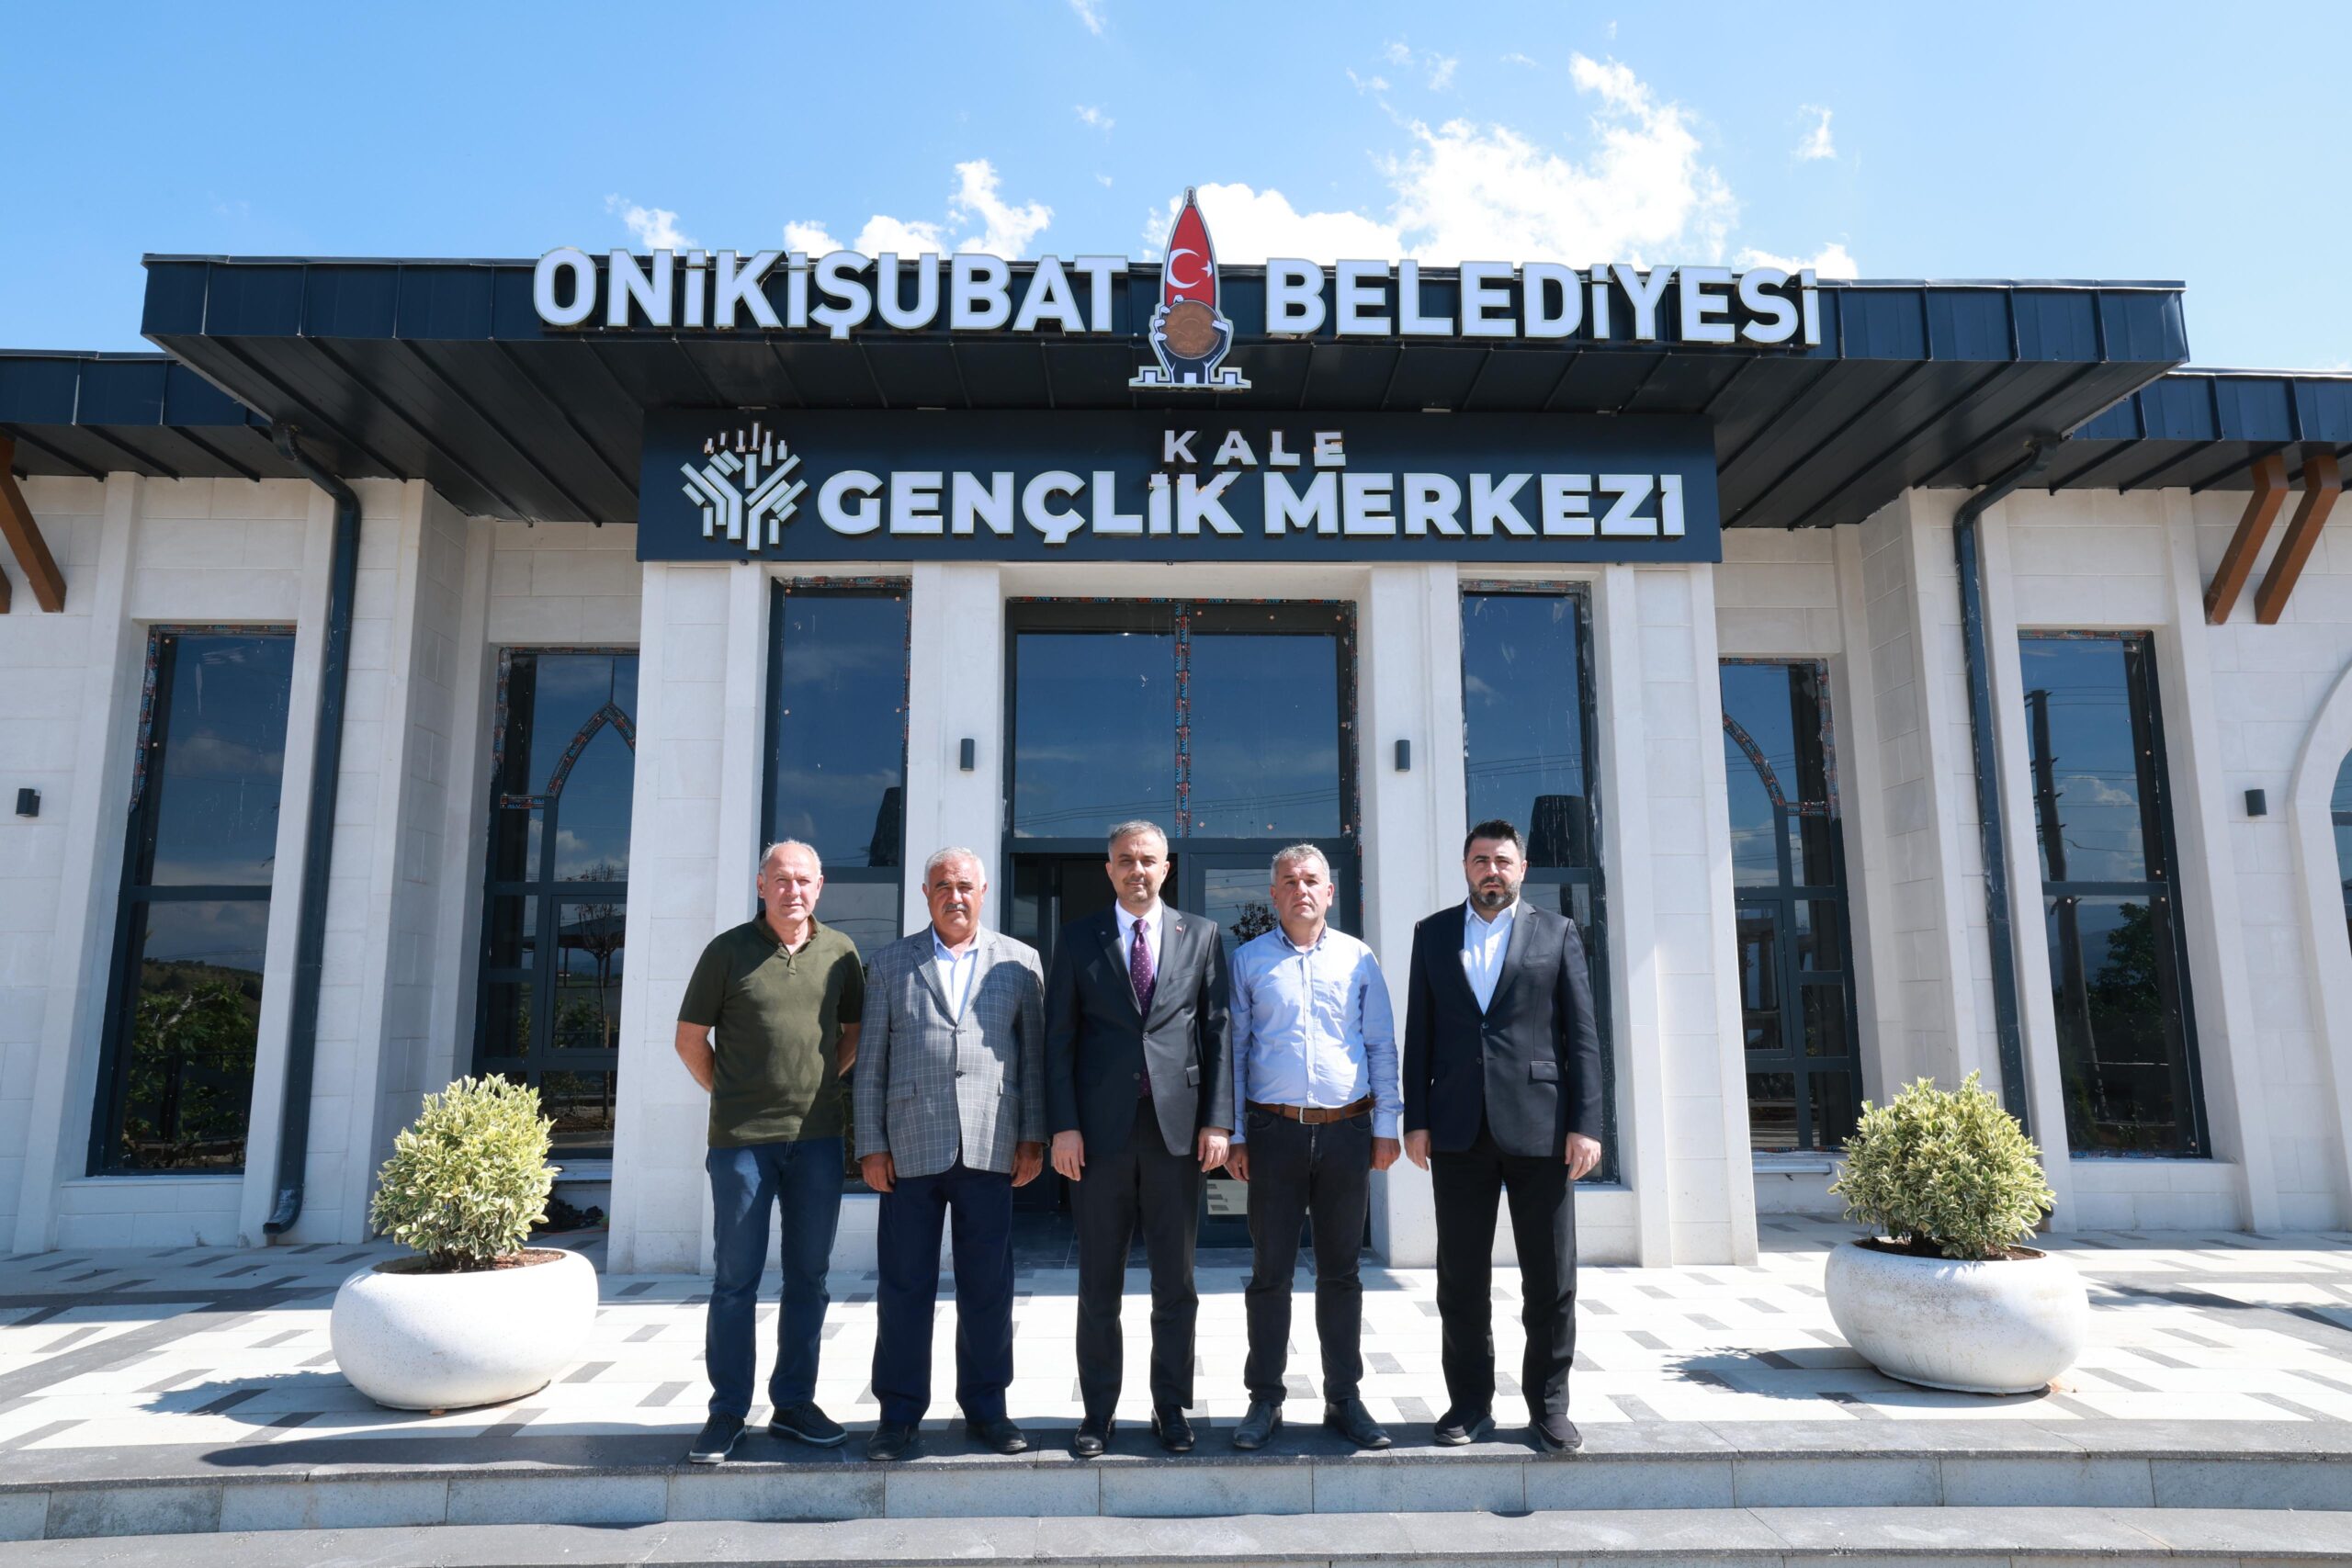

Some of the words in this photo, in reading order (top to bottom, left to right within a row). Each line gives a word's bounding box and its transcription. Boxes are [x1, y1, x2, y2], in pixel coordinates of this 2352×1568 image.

[534, 246, 1128, 340] ONİKİŞUBAT
[1265, 257, 1821, 344] BELEDİYESİ
[1163, 430, 1346, 466] KALE
[818, 470, 1244, 544] GENÇLİK
